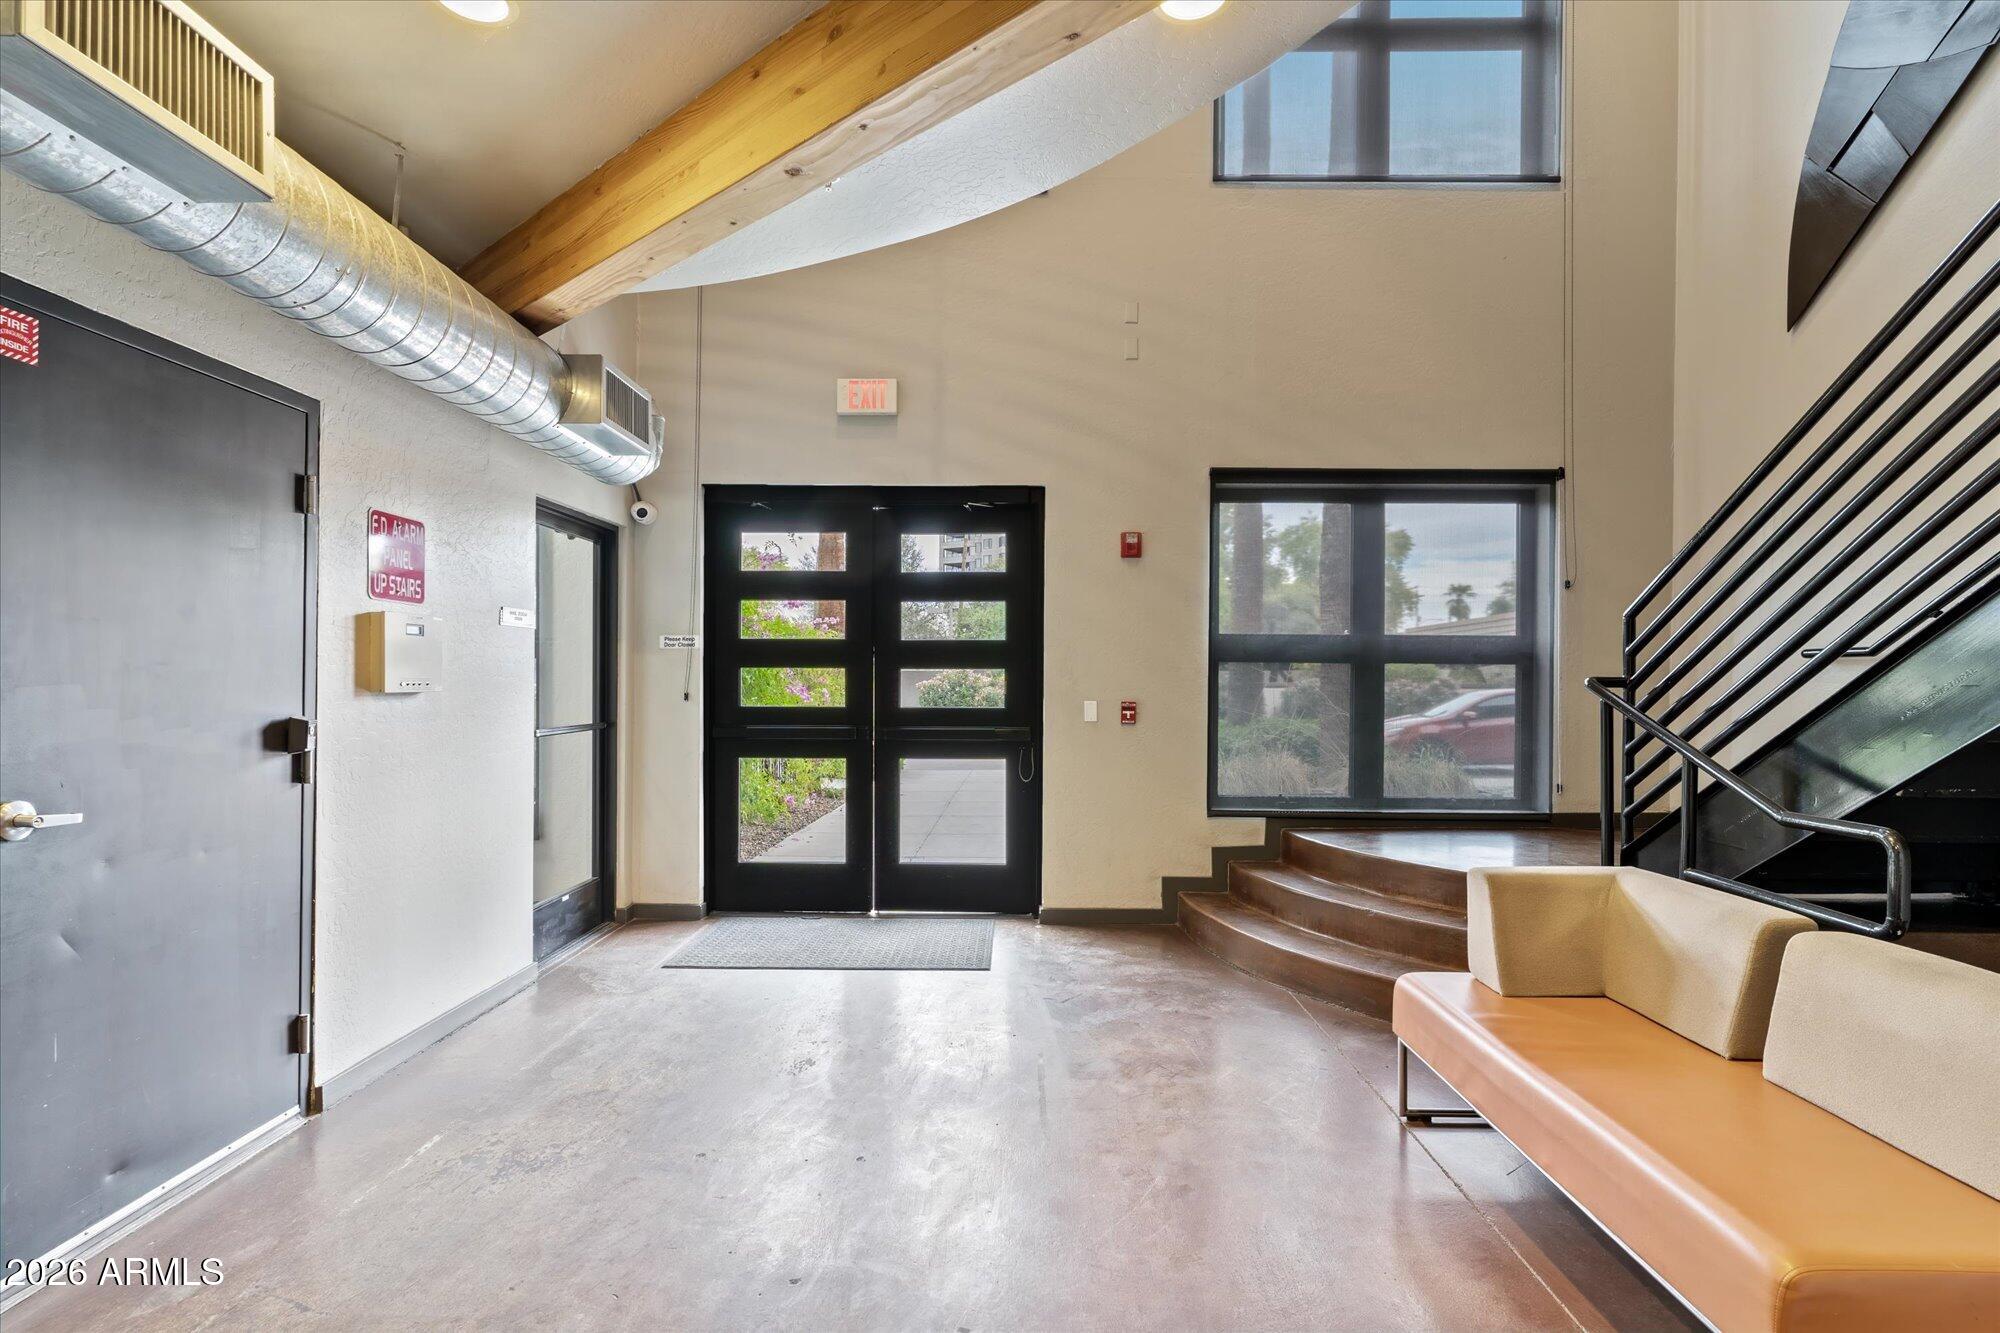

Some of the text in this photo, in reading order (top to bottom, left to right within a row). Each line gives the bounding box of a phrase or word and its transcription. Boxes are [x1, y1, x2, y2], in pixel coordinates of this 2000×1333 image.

[0, 315, 29, 333] FIRE
[0, 328, 33, 346] XTINGUISHER
[848, 378, 887, 409] EXIT
[392, 519, 424, 545] ALARM
[383, 546, 414, 570] PANEL
[373, 573, 422, 599] UP STAIRS
